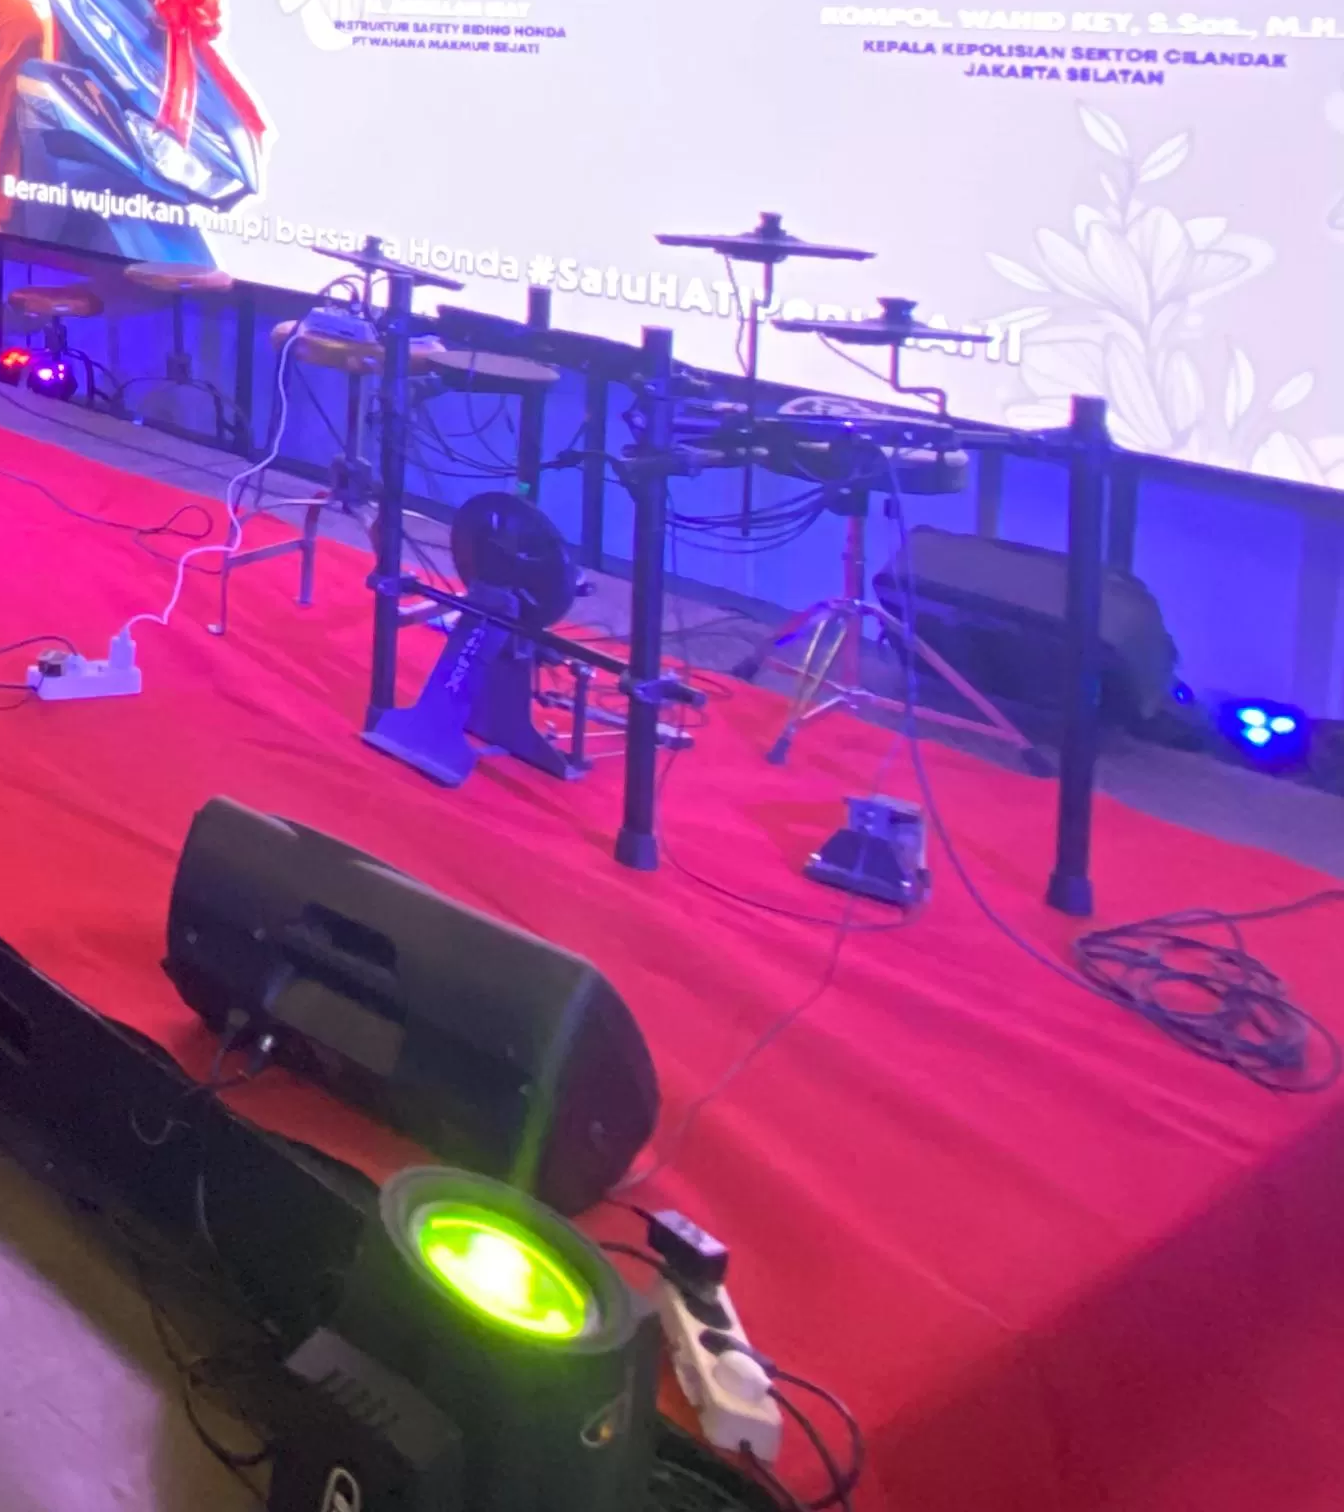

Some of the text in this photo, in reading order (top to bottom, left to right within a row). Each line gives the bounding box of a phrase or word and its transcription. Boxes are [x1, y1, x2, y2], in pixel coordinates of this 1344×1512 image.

[412, 21, 460, 35] SAFETY
[462, 23, 512, 37] RIDING
[514, 24, 567, 39] HONDA
[957, 9, 1067, 33] WAHID
[1070, 13, 1142, 36] KEY,
[351, 35, 541, 55] PT WAHANA MAKMUR SEJATI
[862, 39, 1288, 69] KEPALA KEPOLISIAN SEKTOR CILANDAK
[963, 62, 1165, 86] JAKARTA SELATAN
[3, 174, 68, 207] Berani
[70, 187, 185, 227] wujudkan
[275, 215, 401, 260] bersaa
[408, 238, 520, 281] Honda
